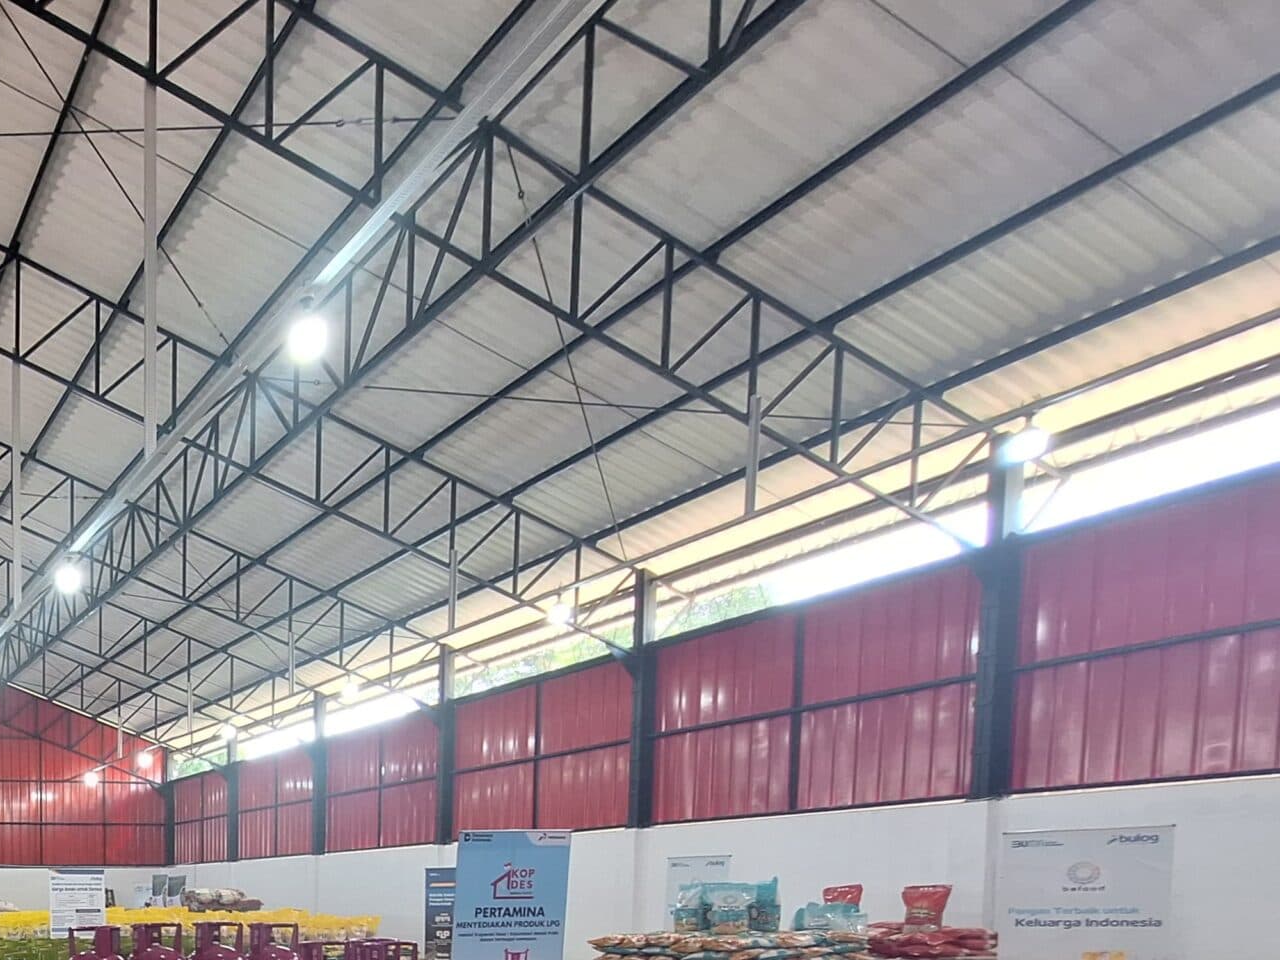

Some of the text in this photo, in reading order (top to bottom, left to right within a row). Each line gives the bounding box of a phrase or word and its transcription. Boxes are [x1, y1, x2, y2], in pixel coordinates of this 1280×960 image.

[1120, 834, 1159, 844] bulog
[511, 869, 535, 878] KOP
[511, 880, 533, 890] DES
[474, 907, 545, 919] PERTAMINA
[456, 920, 560, 929] MENYEDIAKAN PRODUK LPG
[1015, 917, 1162, 929] Keluarga Indonesia
